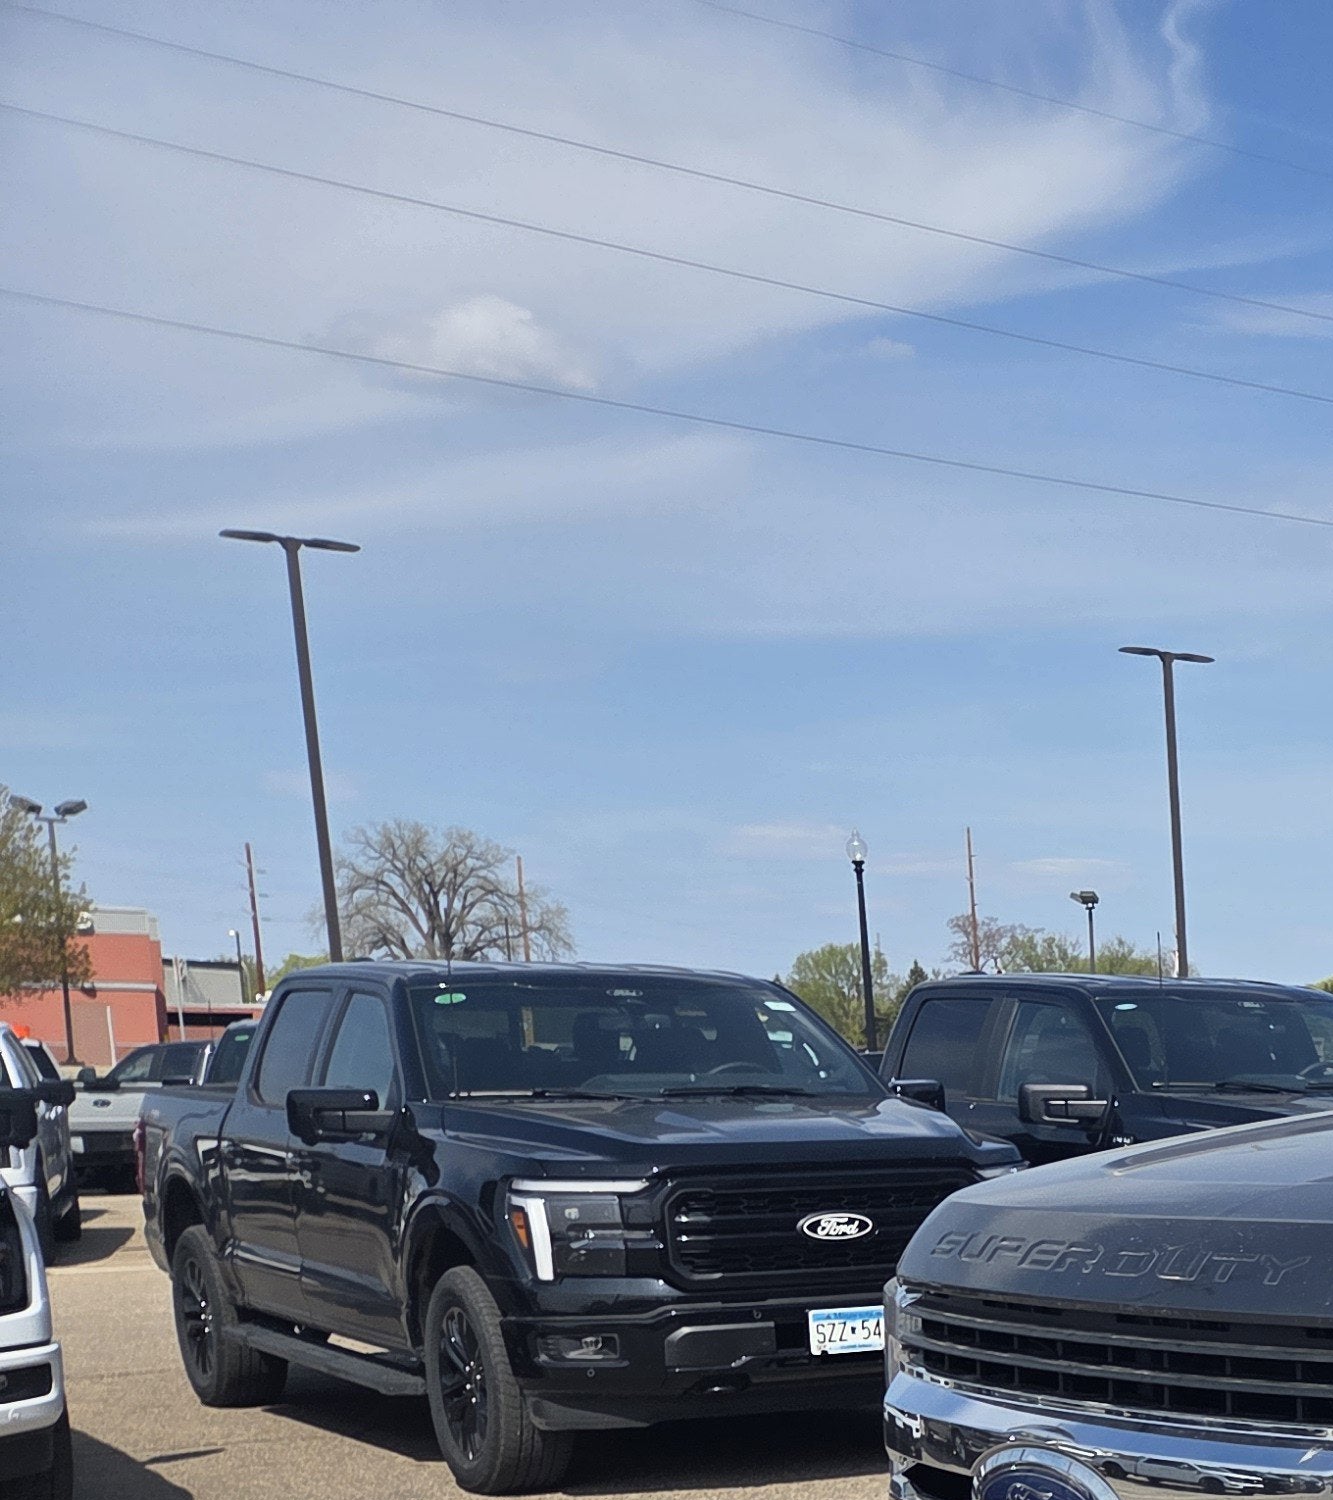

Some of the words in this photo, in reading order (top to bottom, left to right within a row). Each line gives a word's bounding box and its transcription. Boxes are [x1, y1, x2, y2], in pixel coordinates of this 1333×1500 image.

[817, 1217, 859, 1235] Ford
[930, 1231, 1104, 1274] SUPER
[1104, 1244, 1312, 1287] DUTY
[816, 1321, 848, 1344] SZZ
